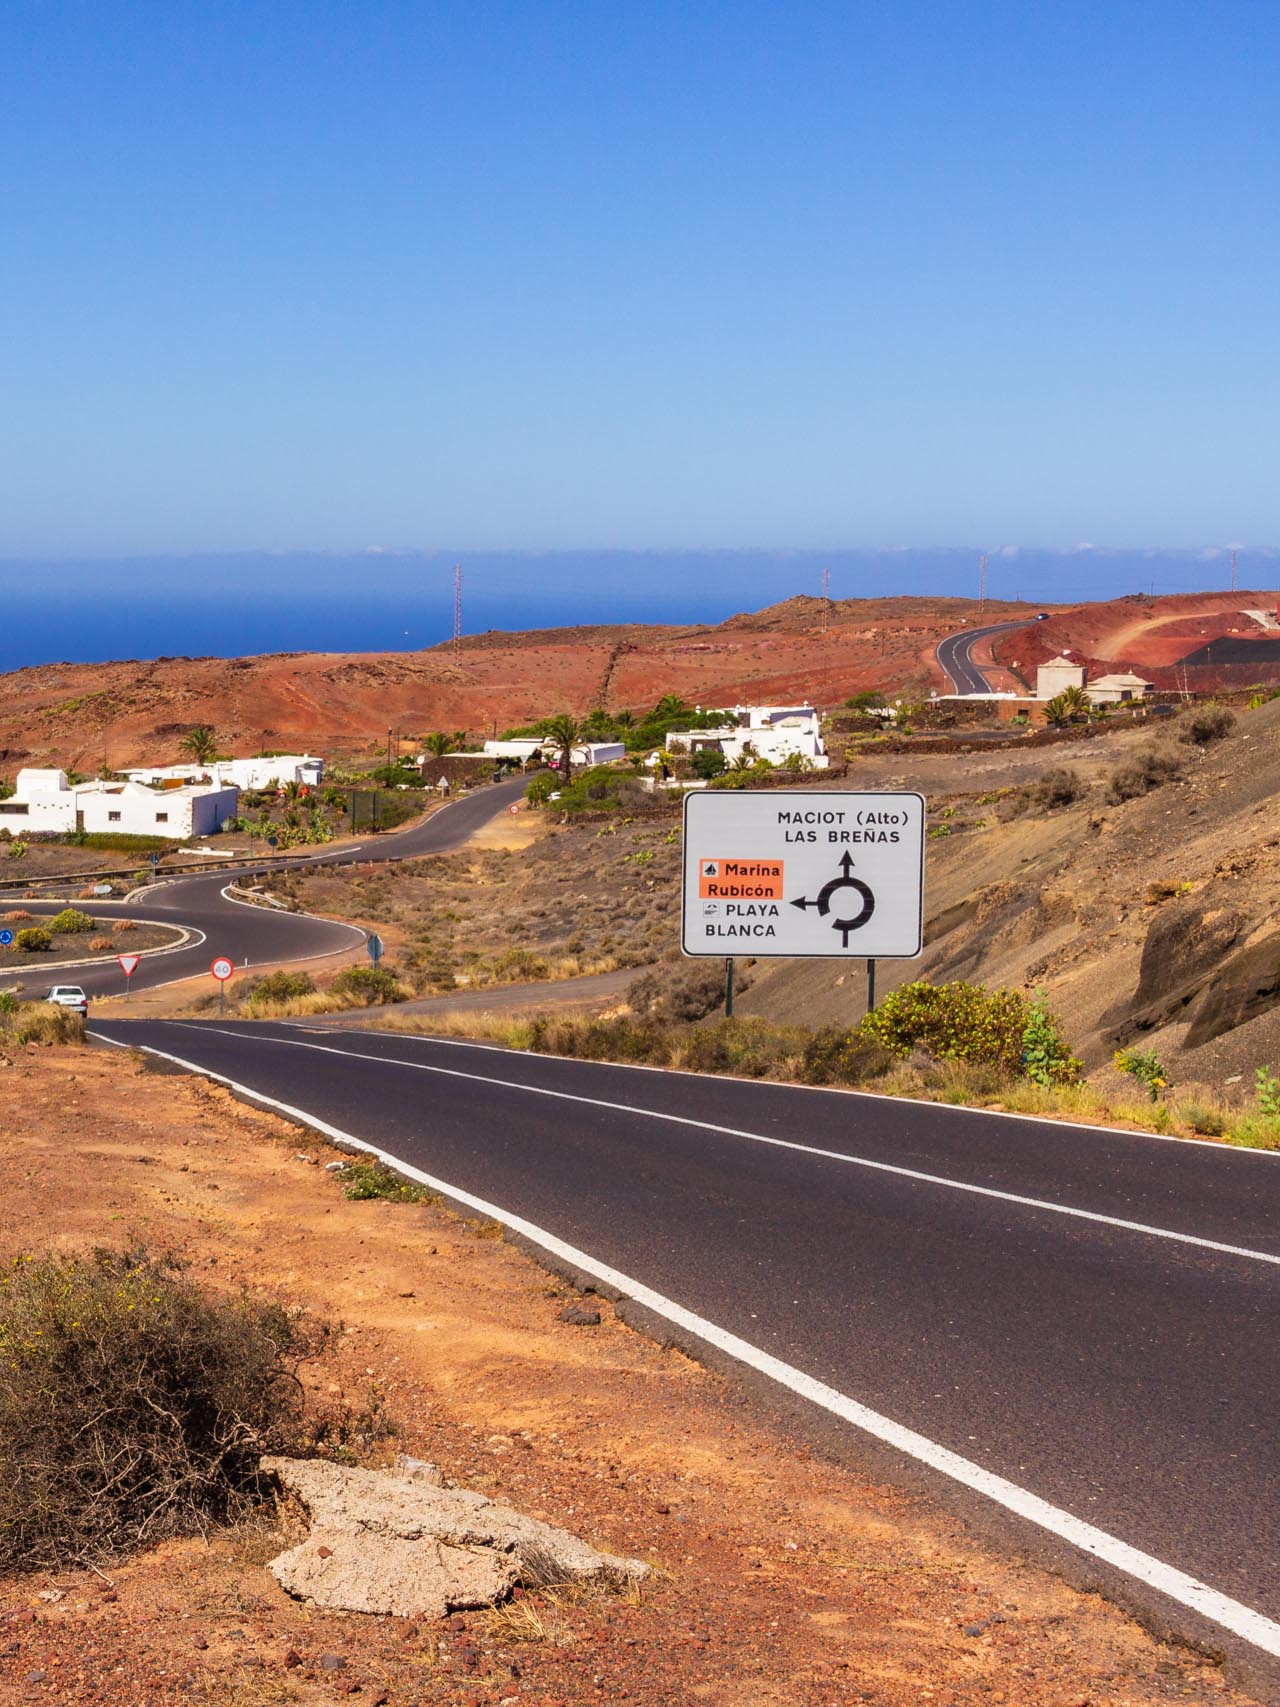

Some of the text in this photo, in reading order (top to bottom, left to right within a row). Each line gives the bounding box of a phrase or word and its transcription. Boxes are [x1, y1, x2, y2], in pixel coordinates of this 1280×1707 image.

[777, 810, 909, 827] MACIOT (Alto)
[784, 828, 900, 844] LAS BREÑAS
[725, 863, 780, 877] Marina
[708, 884, 774, 897] Rubicón
[726, 904, 779, 917] PLAYA
[705, 924, 776, 937] BLANCA
